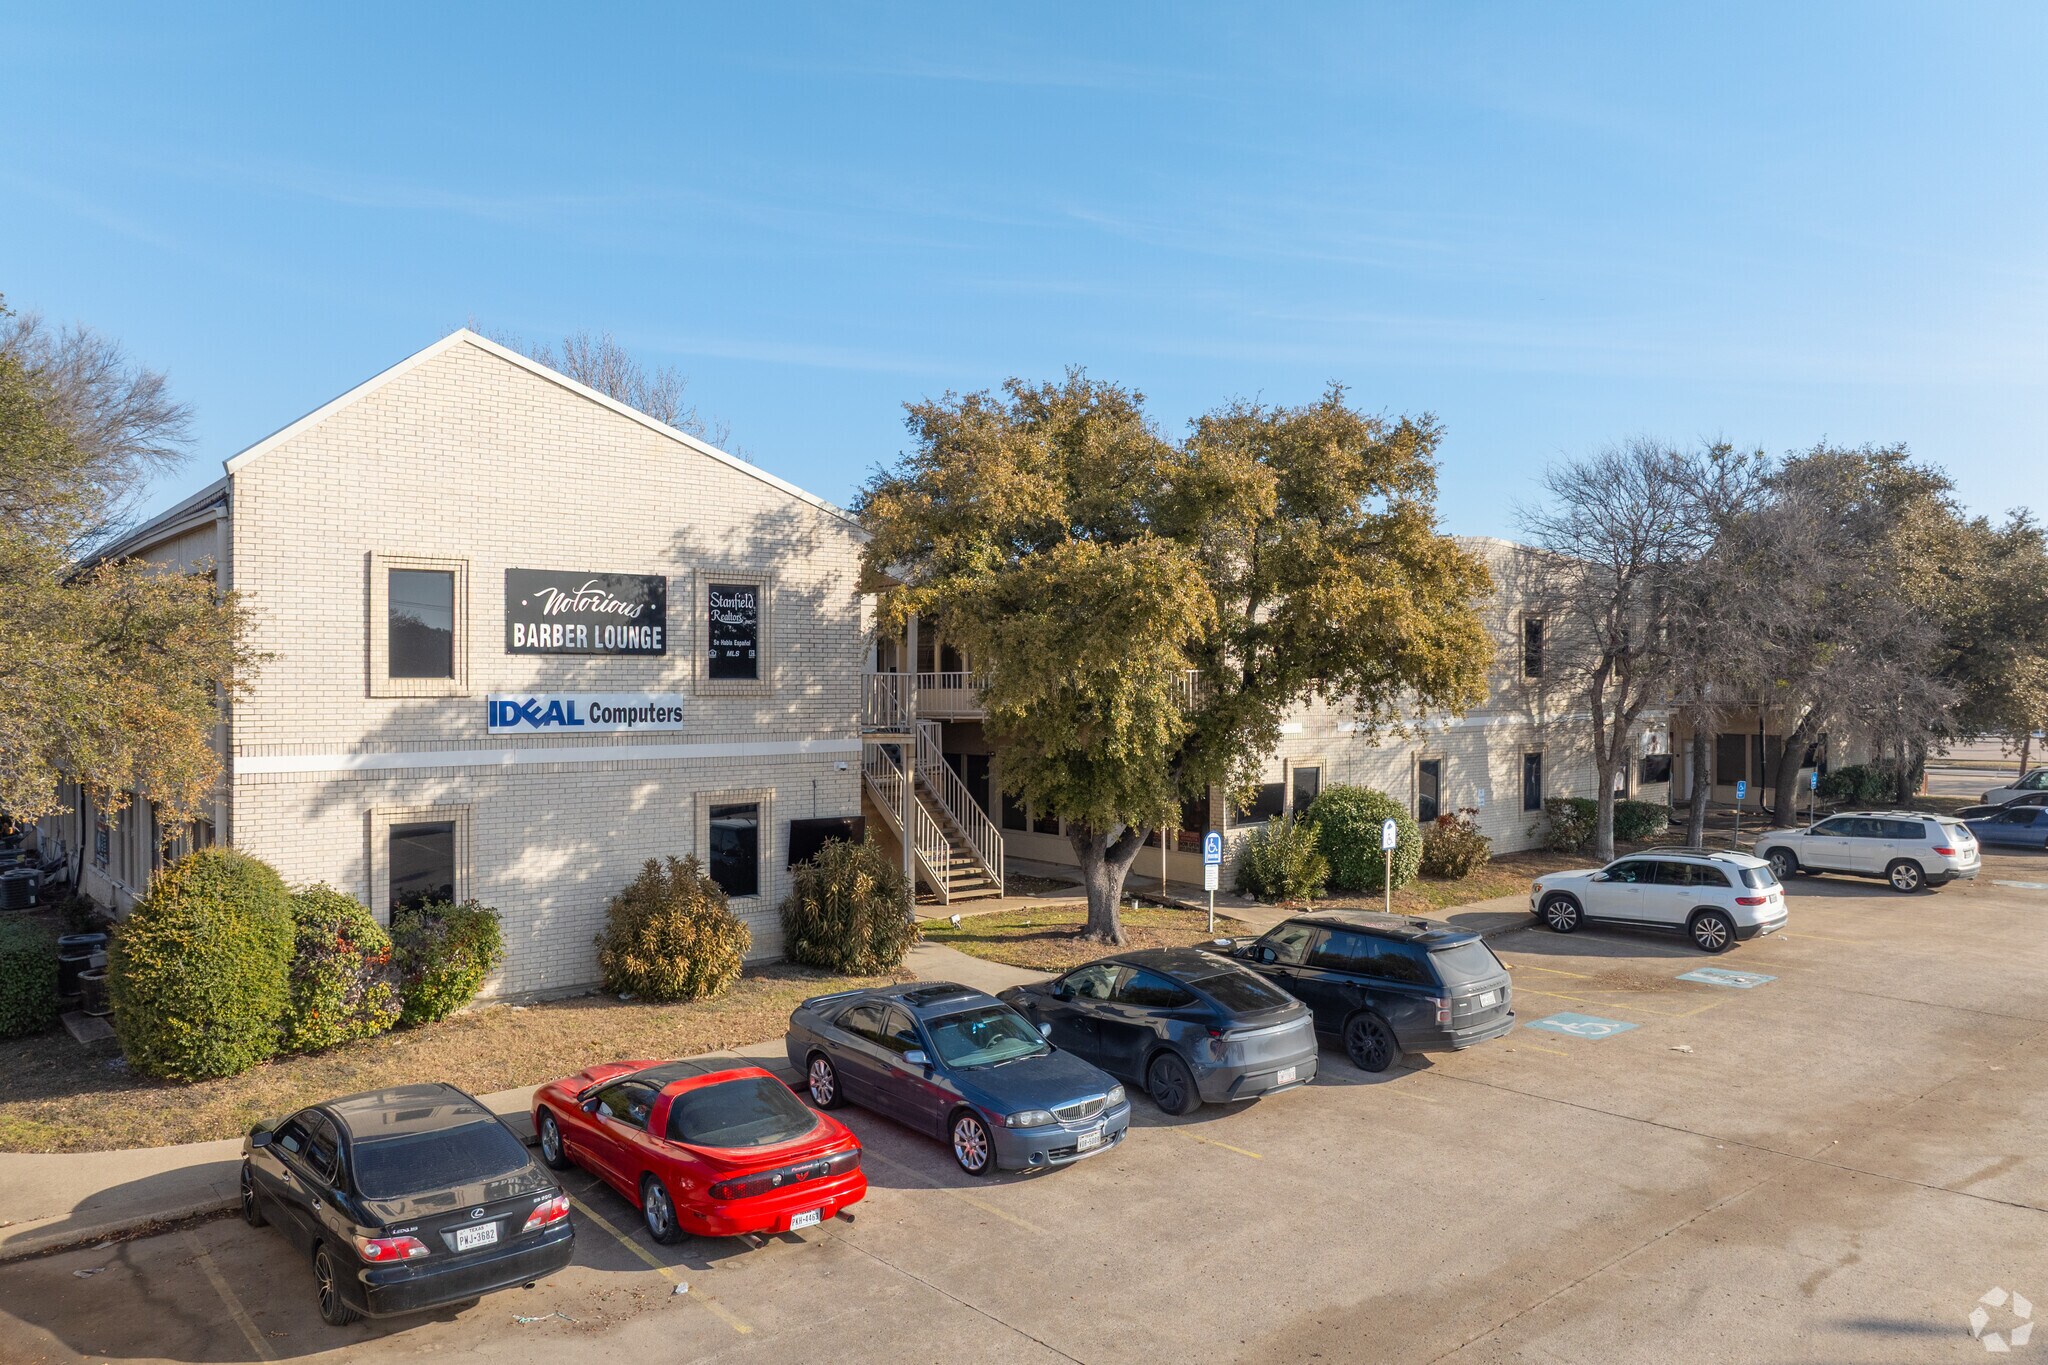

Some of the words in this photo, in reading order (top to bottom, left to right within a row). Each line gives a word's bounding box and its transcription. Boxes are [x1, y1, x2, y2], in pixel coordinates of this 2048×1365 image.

[534, 580, 644, 618] Notorious
[710, 591, 754, 610] Stanfield
[710, 609, 743, 624] Realtors
[514, 623, 588, 648] BARBER
[595, 625, 662, 649] LOUNGE
[489, 697, 585, 729] IDEAL
[589, 702, 683, 727] Computers
